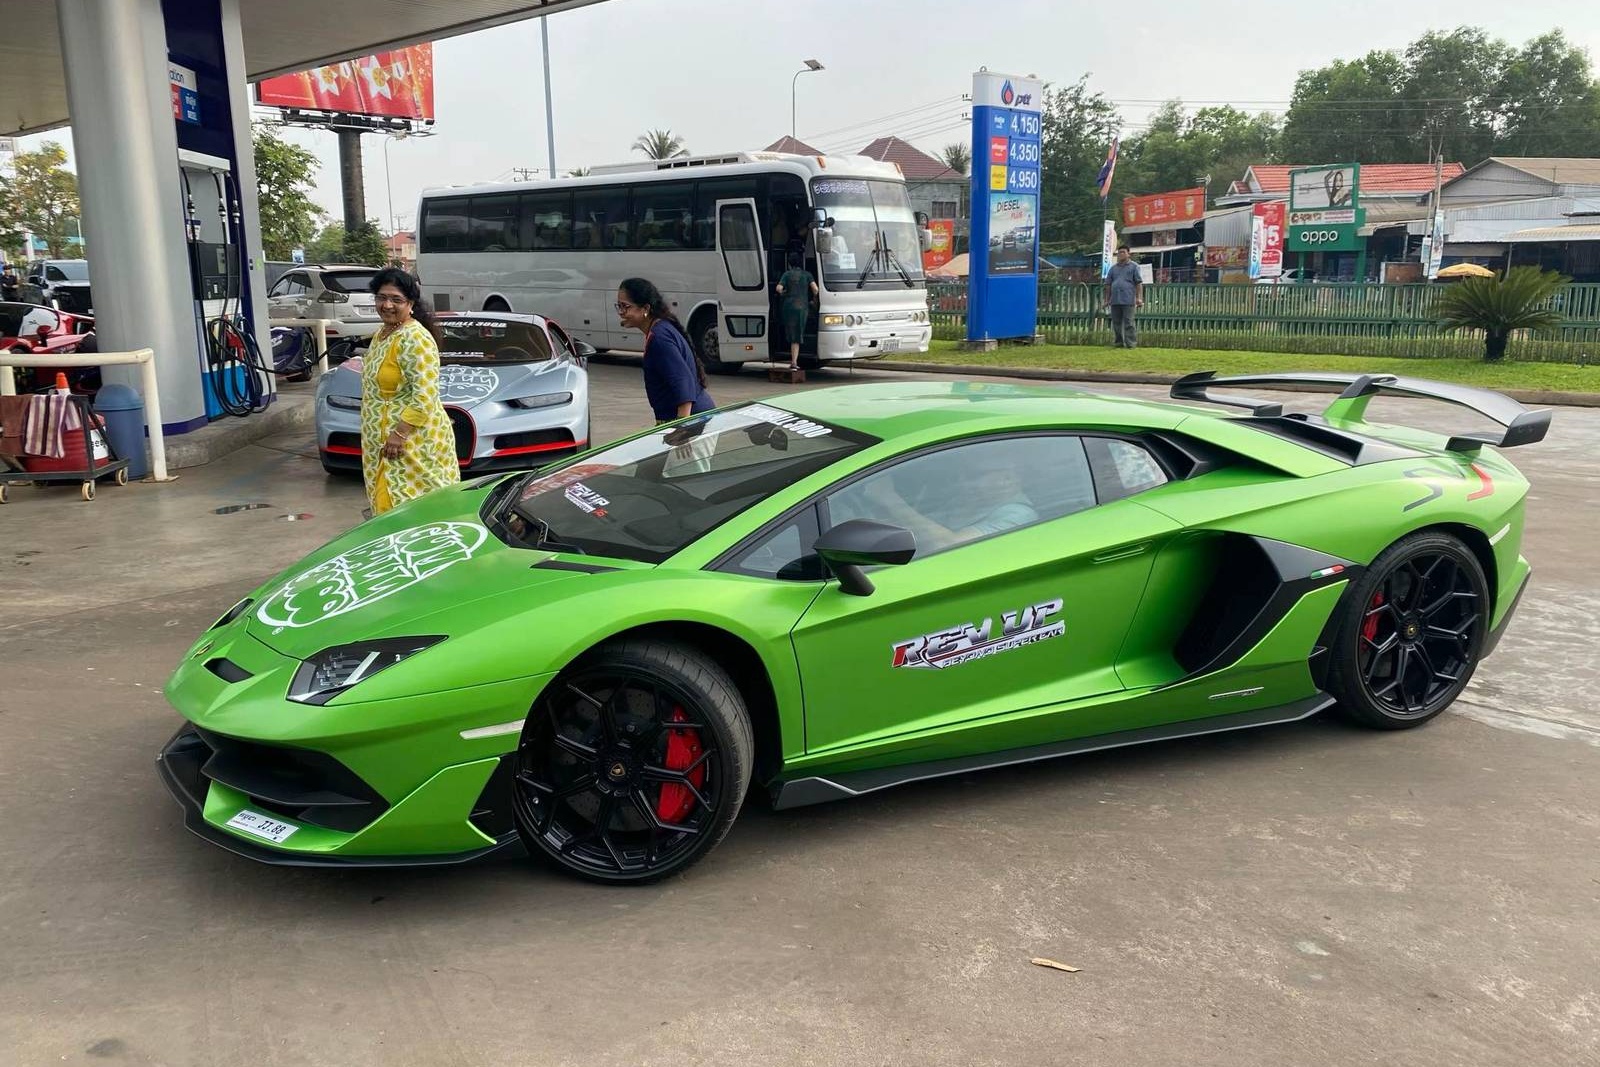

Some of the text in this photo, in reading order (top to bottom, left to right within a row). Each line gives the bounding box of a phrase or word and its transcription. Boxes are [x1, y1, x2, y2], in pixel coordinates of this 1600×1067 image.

[1015, 94, 1032, 107] ptt
[997, 200, 1021, 212] DIESEL
[1300, 230, 1338, 245] oppo
[782, 419, 833, 438] 3000
[892, 598, 1064, 668] REV UP
